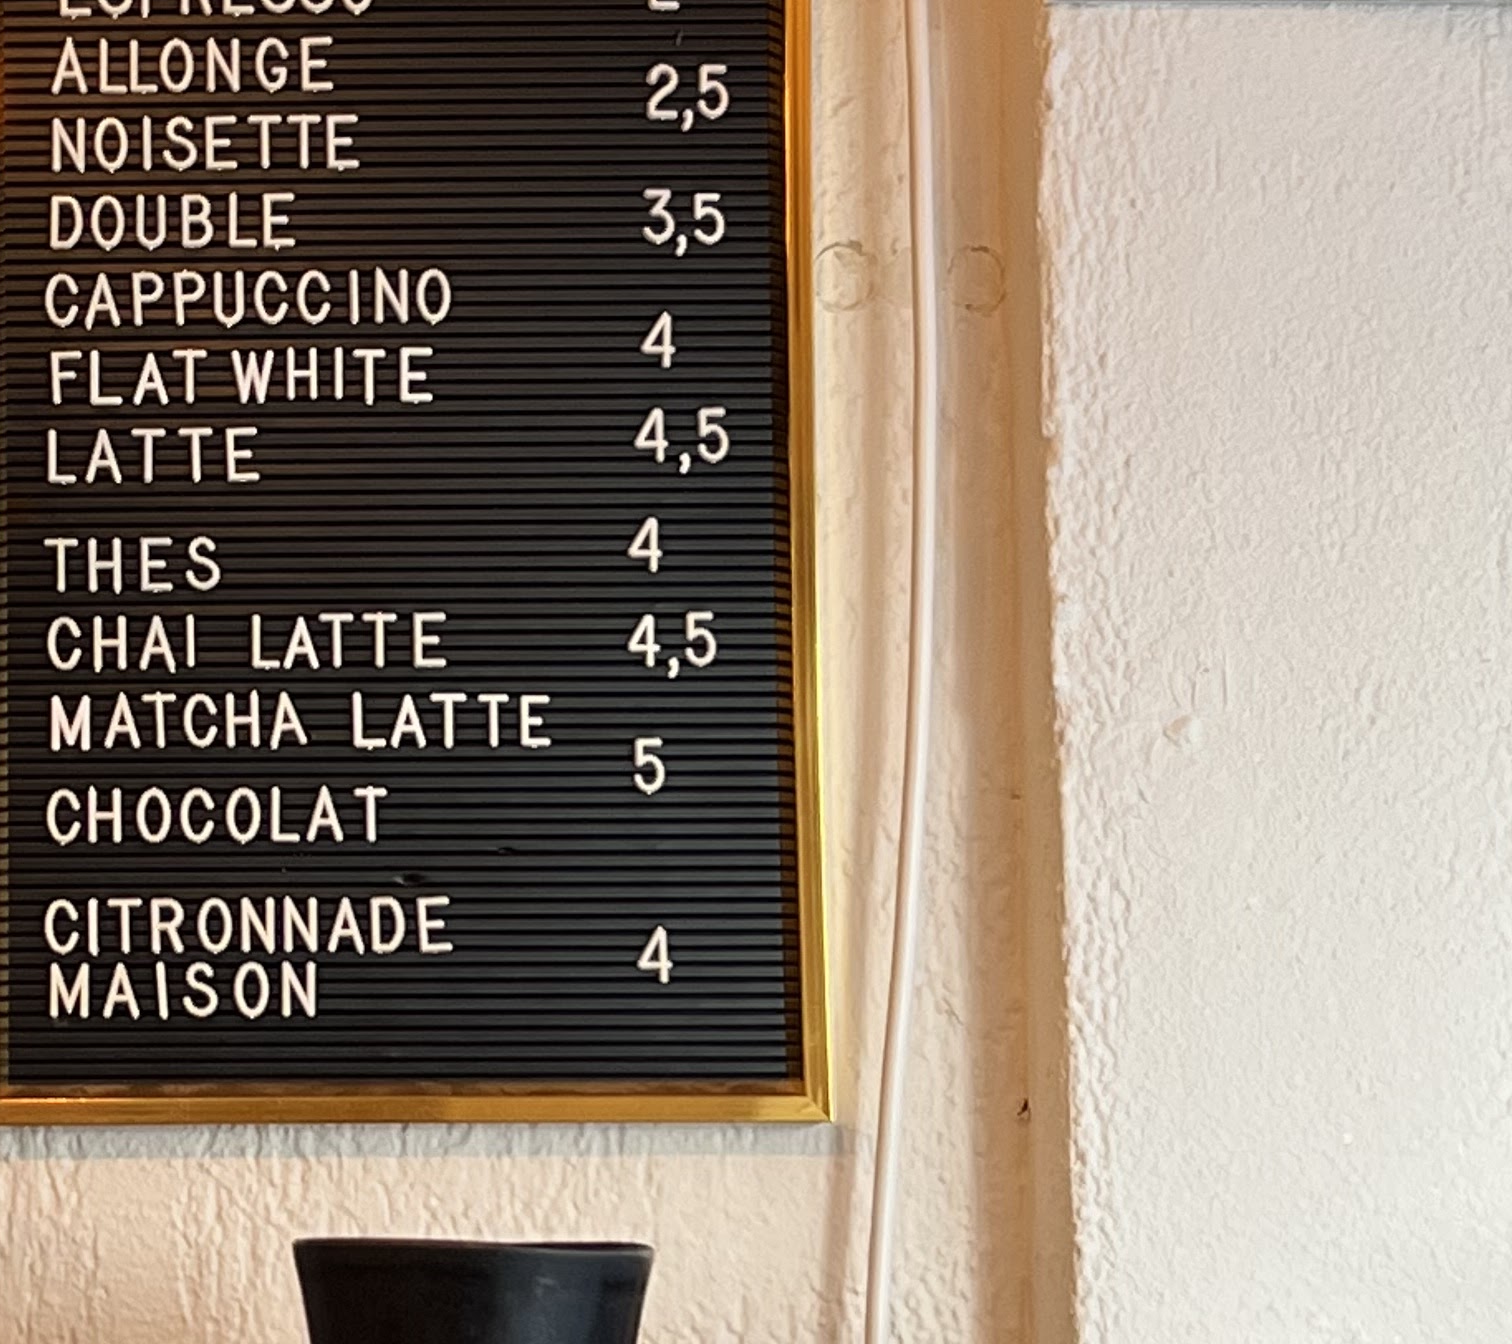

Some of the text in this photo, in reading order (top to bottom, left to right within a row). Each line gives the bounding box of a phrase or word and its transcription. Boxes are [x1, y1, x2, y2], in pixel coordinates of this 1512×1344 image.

[52, 36, 333, 94] ALLONGE
[647, 64, 728, 131] 2,5
[52, 114, 359, 173] NOISETTE
[50, 192, 295, 251] DOUBLE
[644, 189, 724, 256] 3,5
[45, 267, 451, 330] CAPPUCCINO
[641, 311, 675, 367] 4
[51, 347, 433, 405] FLAT WHITE
[48, 427, 259, 485] LATTE
[635, 407, 729, 474] 4,5
[44, 537, 220, 594] THES
[628, 518, 662, 572] 4
[48, 612, 446, 673] CHAI LATTE
[628, 611, 716, 678] 4,5
[51, 690, 551, 751] MATCHA LATTE
[634, 737, 665, 795] 5
[47, 785, 387, 845] CHOCOLAT
[45, 896, 453, 956] CITRONNADE
[638, 926, 673, 983] 4
[50, 961, 316, 1020] MAISON
